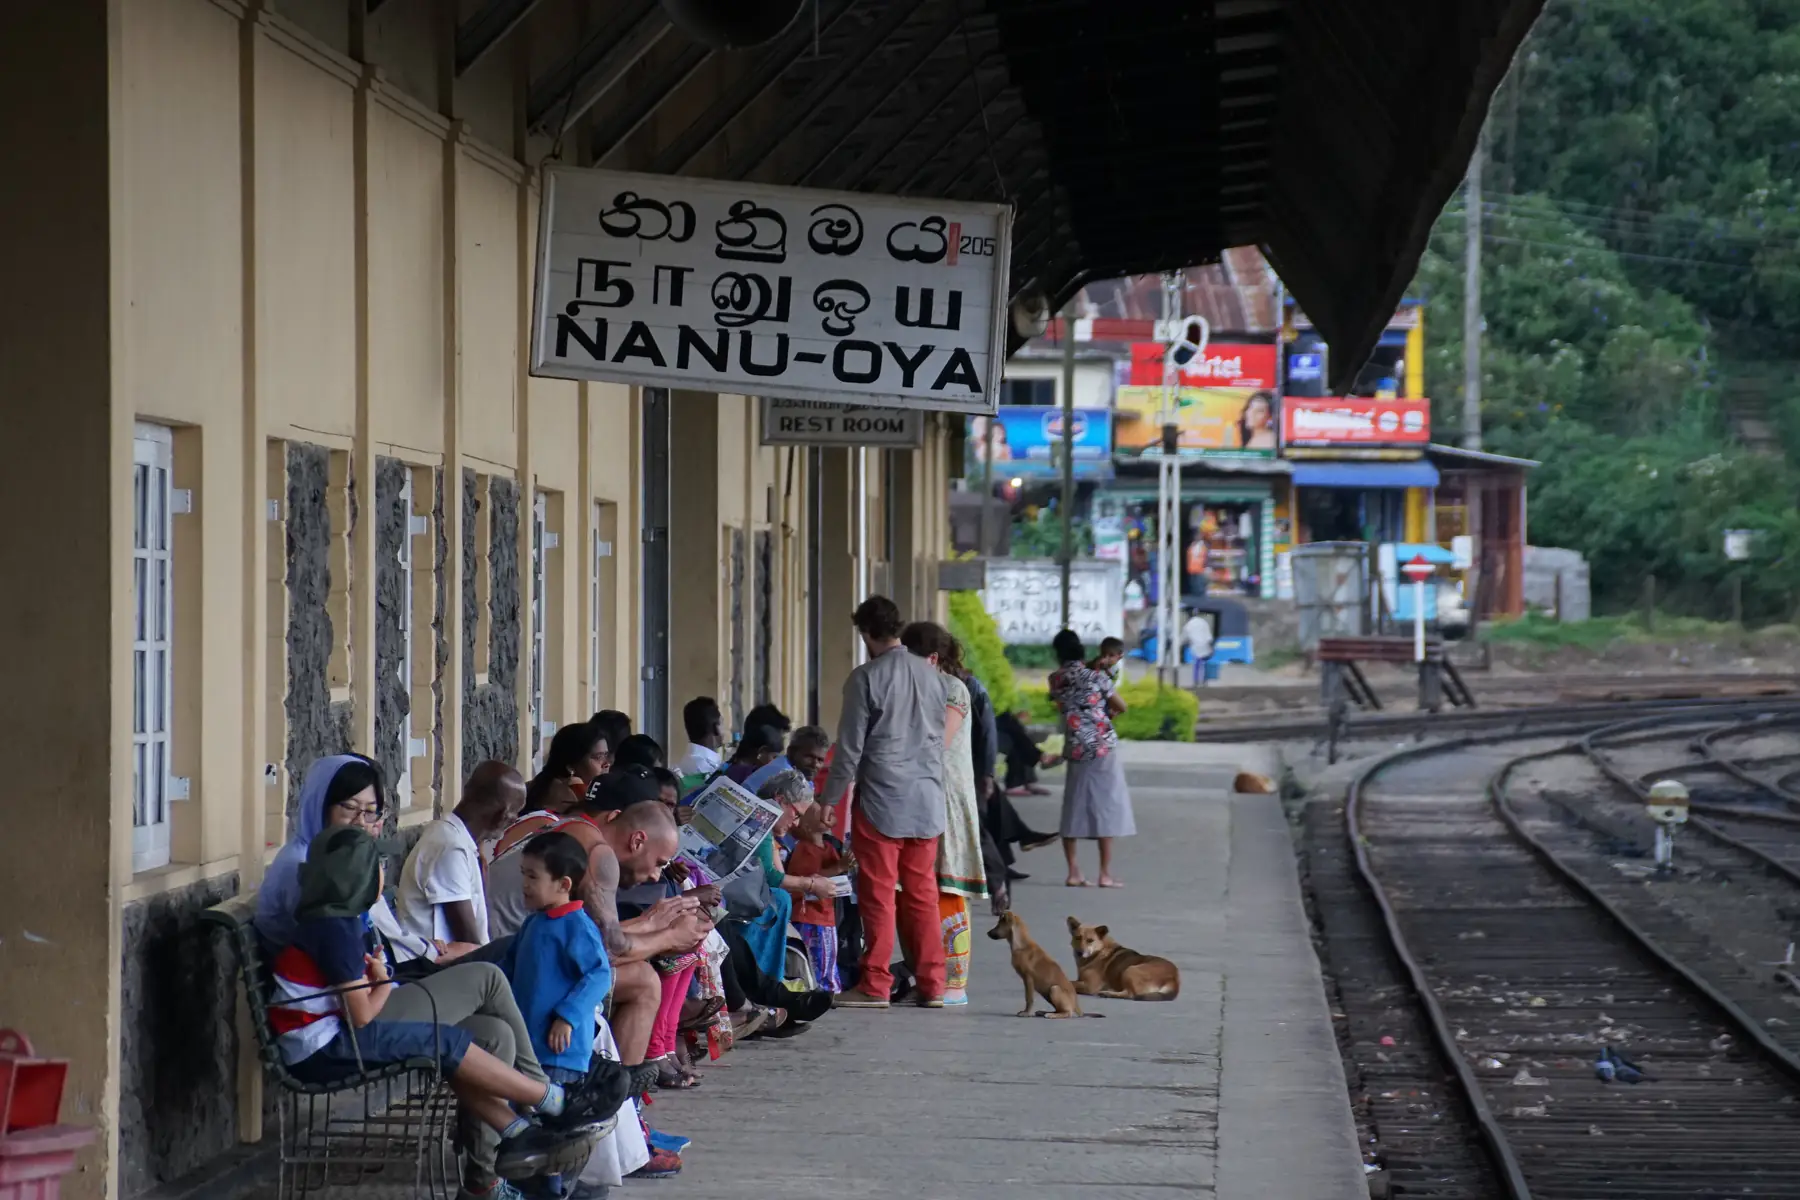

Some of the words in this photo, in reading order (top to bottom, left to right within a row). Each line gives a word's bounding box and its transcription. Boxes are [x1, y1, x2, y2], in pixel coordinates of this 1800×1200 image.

[959, 236, 996, 257] 205
[555, 313, 984, 394] NANU-OYA
[779, 416, 836, 432] REST
[842, 417, 904, 433] ROOM
